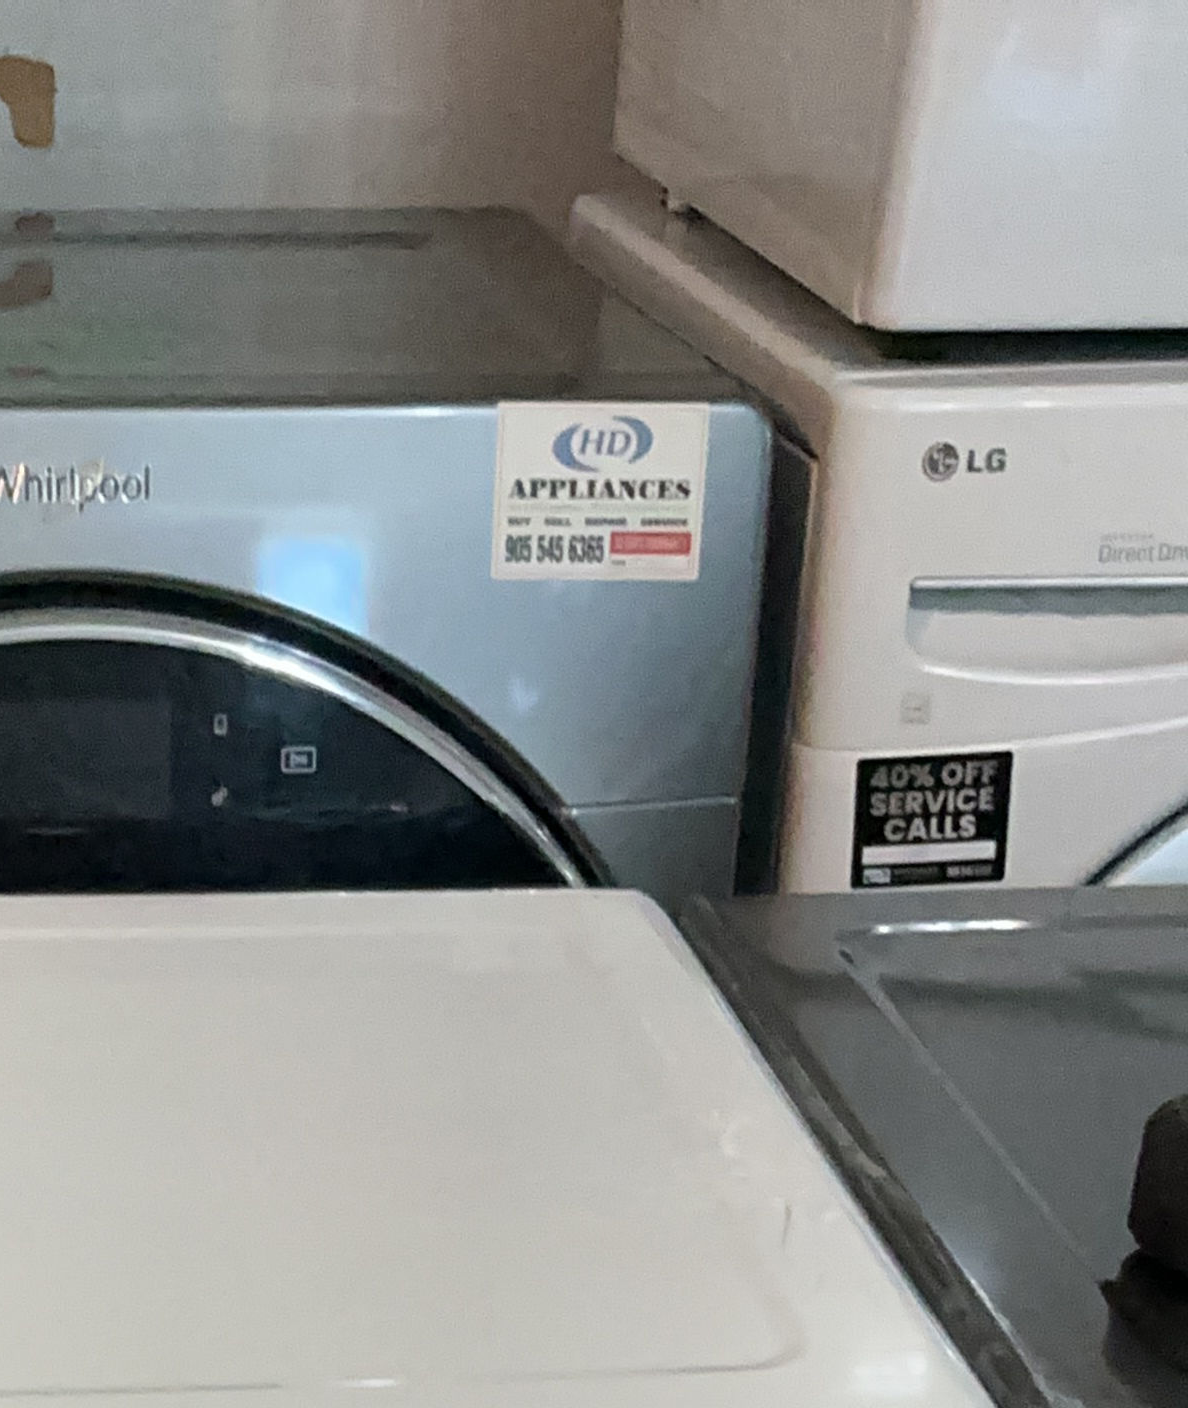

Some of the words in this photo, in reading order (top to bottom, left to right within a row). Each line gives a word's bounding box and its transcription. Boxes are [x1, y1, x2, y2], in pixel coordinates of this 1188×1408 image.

[579, 428, 632, 457] HD
[966, 448, 1007, 474] LG
[509, 479, 692, 500] APPLIANCES
[505, 534, 532, 563] 905
[536, 534, 564, 563] 545
[568, 534, 605, 564] 6365
[870, 764, 934, 788] 40%
[942, 760, 998, 785] OFF
[870, 788, 995, 816] SERVICE
[884, 815, 977, 842] CALLS
